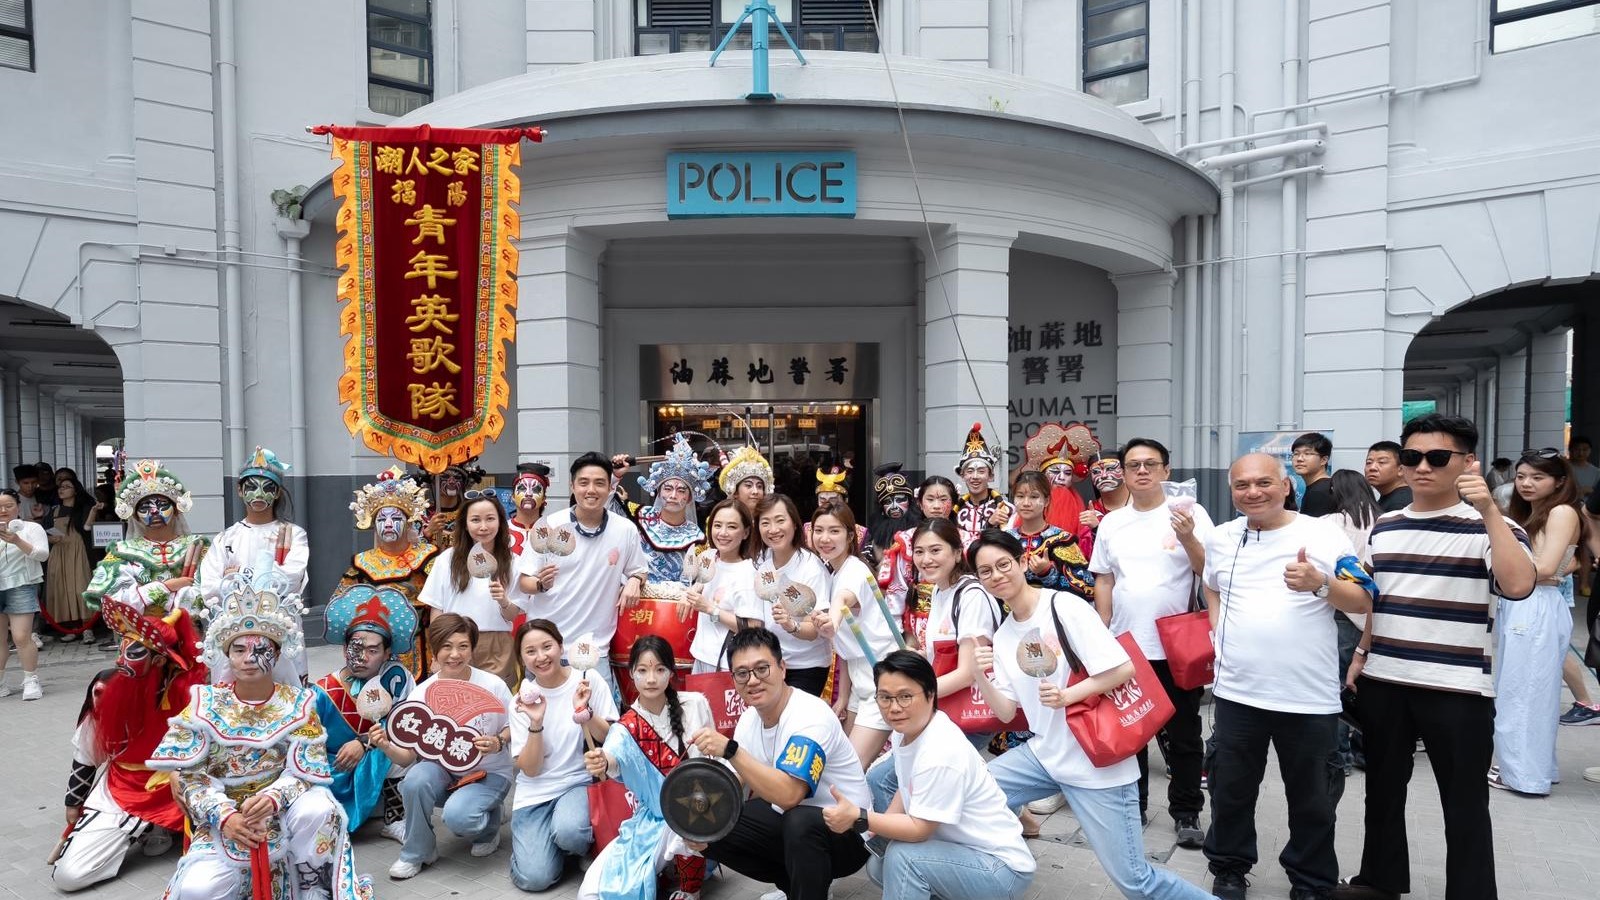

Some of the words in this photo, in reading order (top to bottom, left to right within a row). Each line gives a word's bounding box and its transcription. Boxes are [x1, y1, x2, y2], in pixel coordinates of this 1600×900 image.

[375, 145, 480, 176] 潮人之家
[678, 162, 845, 204] POLICE
[403, 204, 462, 420] 青年英歌隊
[1022, 354, 1084, 385] 警署
[1039, 396, 1076, 417] MA
[1081, 395, 1117, 415] TE
[396, 712, 474, 762] 紅桃粿
